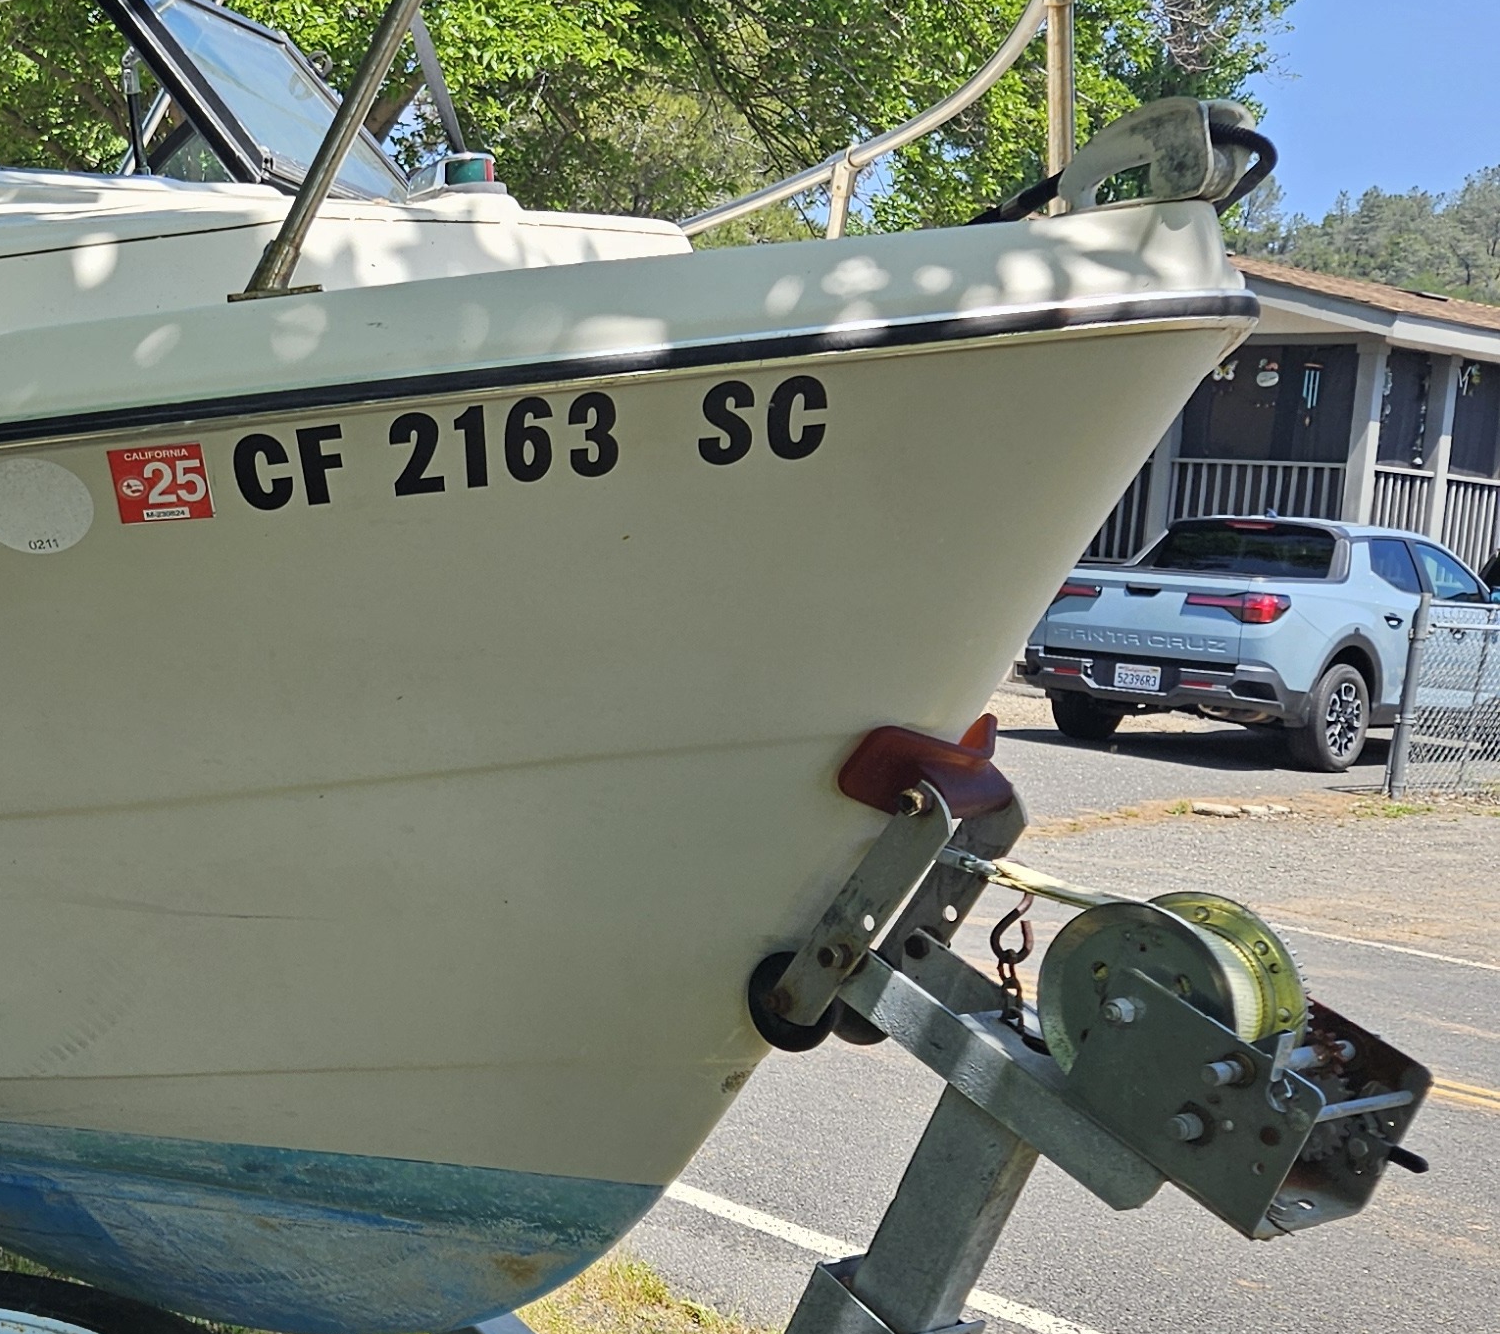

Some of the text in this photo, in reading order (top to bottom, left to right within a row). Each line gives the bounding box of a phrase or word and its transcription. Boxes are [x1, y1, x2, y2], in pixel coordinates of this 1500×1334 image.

[233, 375, 828, 510] CF 2163 SC
[124, 448, 188, 461] CALIFORNIA
[143, 459, 206, 504] 25
[28, 538, 59, 550] 0211
[1148, 636, 1226, 653] CRUZ
[1117, 672, 1157, 687] 52396R3
